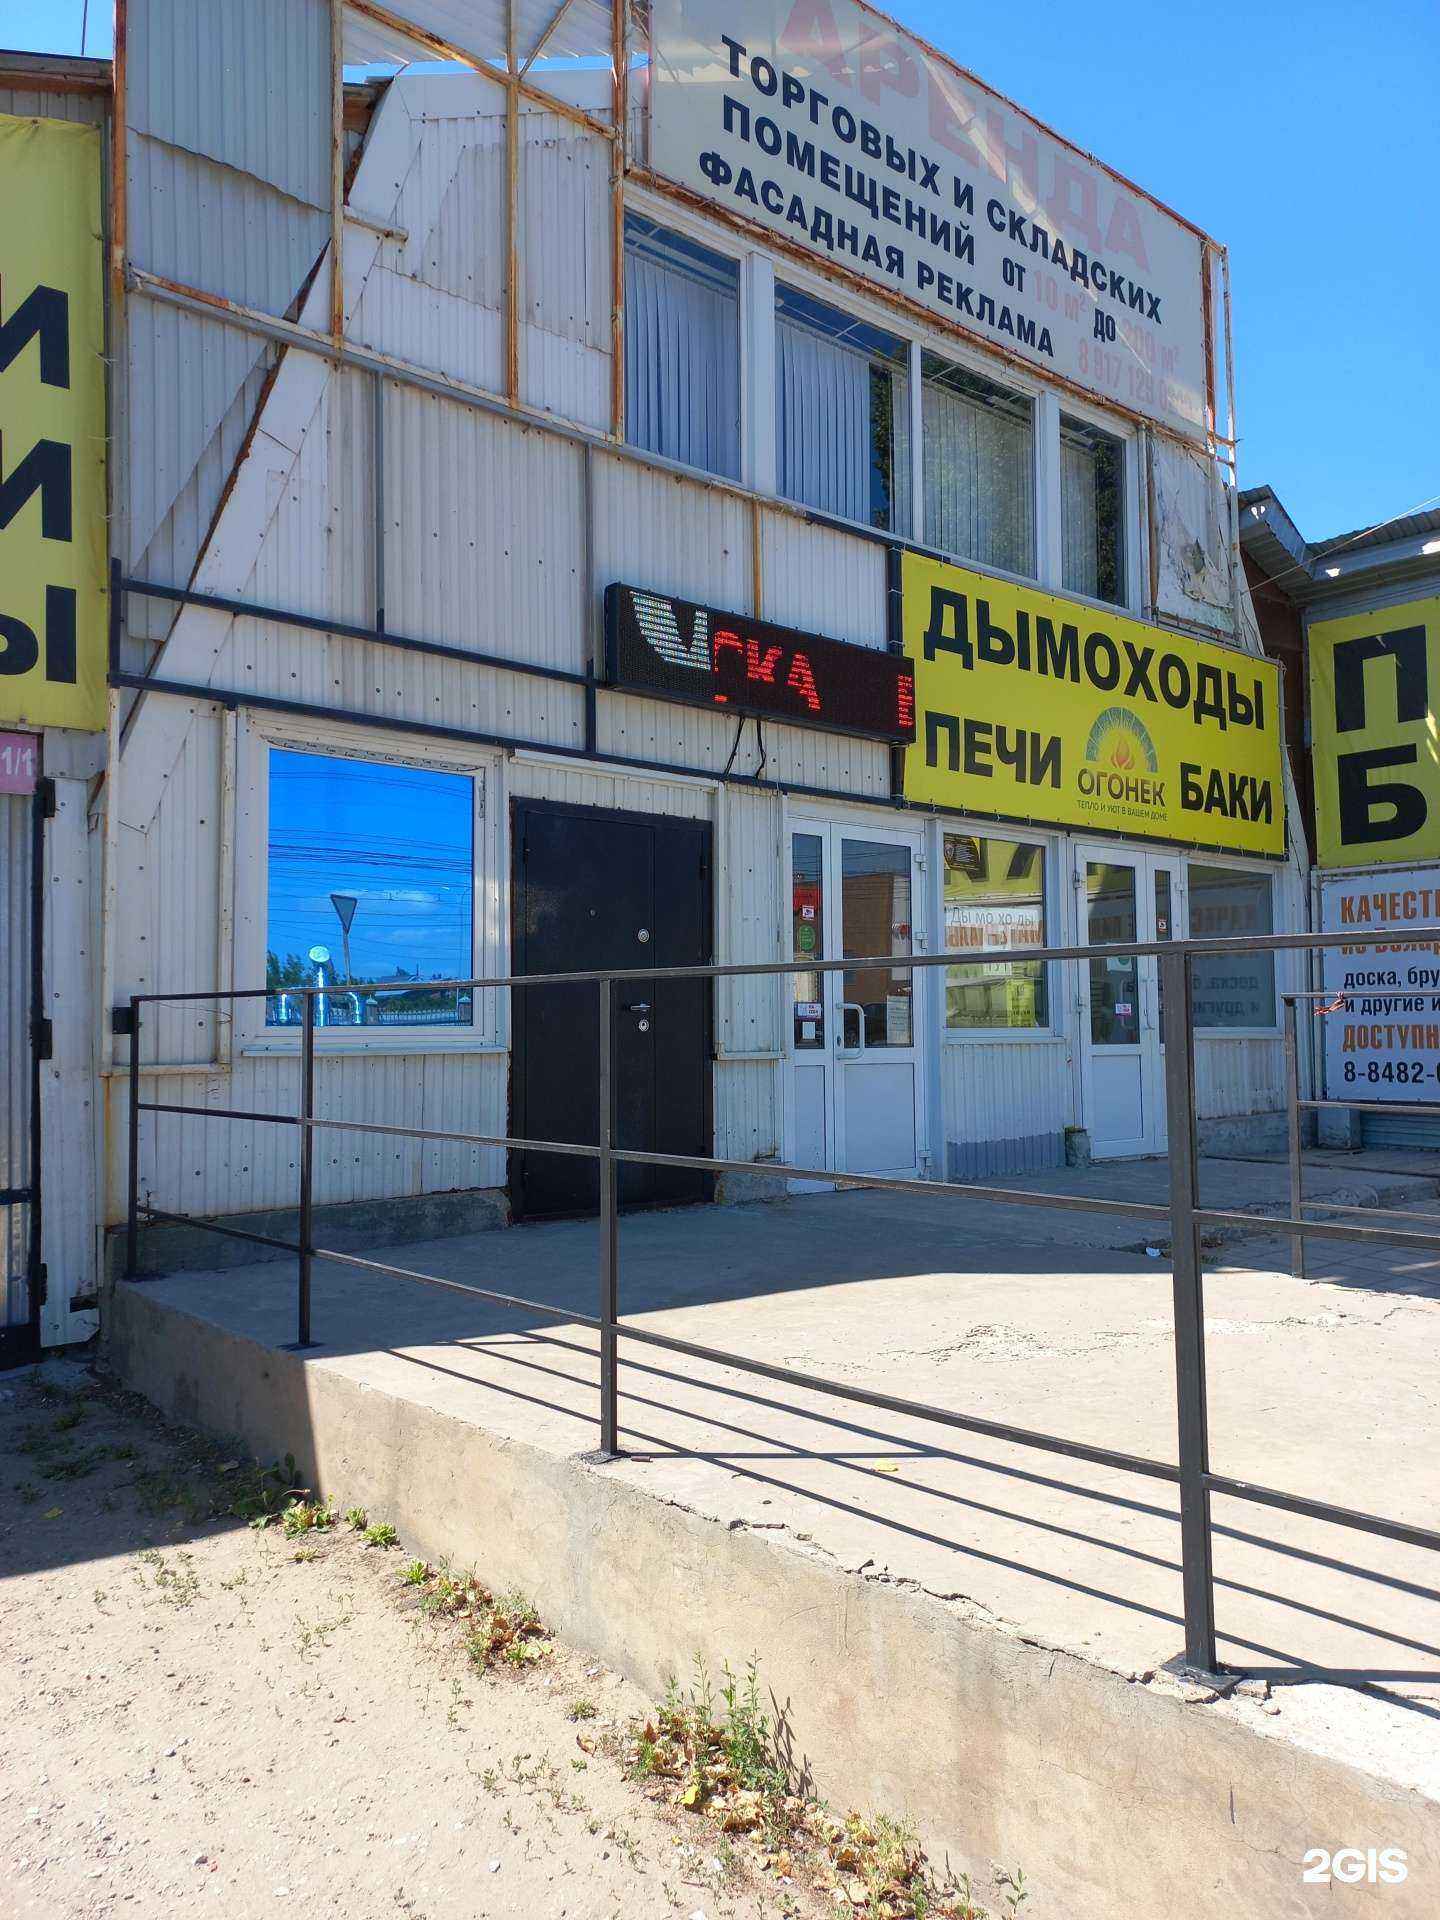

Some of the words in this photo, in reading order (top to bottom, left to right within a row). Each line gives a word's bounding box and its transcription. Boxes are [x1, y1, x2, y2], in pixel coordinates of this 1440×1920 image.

[721, 34, 941, 197] ТОРГОВЫХ
[953, 176, 974, 217] И
[986, 199, 1162, 325] СКЛАДСКИХ
[723, 94, 976, 266] ПОМЕЩЕНИЙ
[1002, 257, 1027, 293] ОТ
[1093, 308, 1116, 343] ДО
[699, 151, 905, 280] ФАСАДНАЯ
[917, 260, 1054, 358] РЕКЛАМА
[923, 585, 1265, 731] ДЫМОХОДЫ
[1333, 625, 1428, 733] П
[925, 710, 1062, 789] ПЕЧИ
[1077, 768, 1166, 807] ОГОНЕК
[1077, 800, 1099, 812] ТЕПЛО
[1127, 807, 1150, 818] ВАШЕМ
[1180, 762, 1272, 825] БАКИ
[1337, 743, 1428, 846] Б
[1340, 889, 1440, 924] КАЧЕСТ
[1343, 971, 1402, 989] доска,
[1344, 998, 1355, 1013] и
[1361, 996, 1425, 1017] другие
